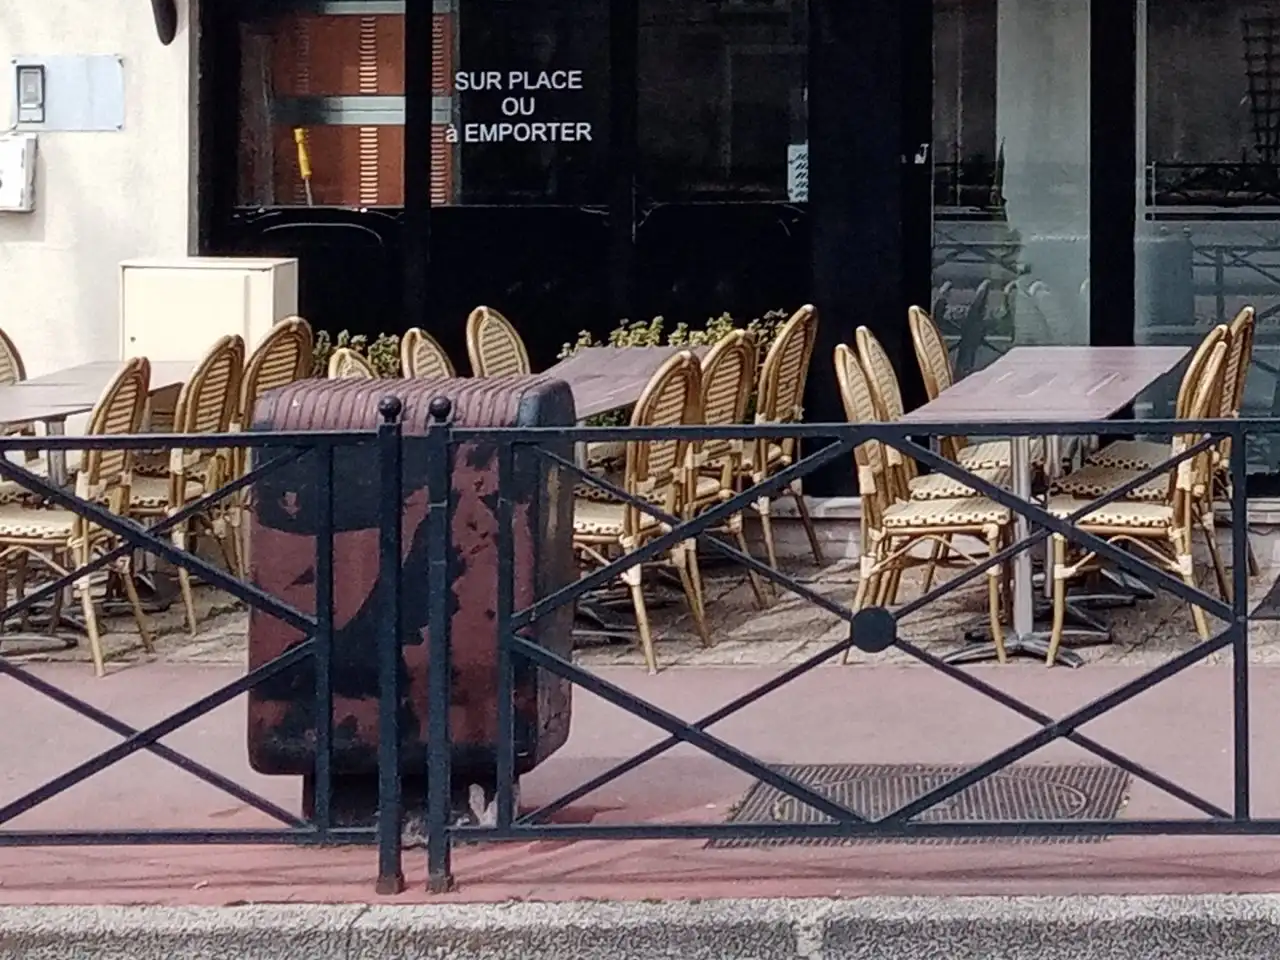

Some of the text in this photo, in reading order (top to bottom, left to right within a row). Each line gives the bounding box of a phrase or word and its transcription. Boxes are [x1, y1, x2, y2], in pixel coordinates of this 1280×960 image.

[454, 70, 583, 92] SUR PLACE
[501, 96, 535, 117] OU
[445, 121, 593, 143] à EMPORTER
